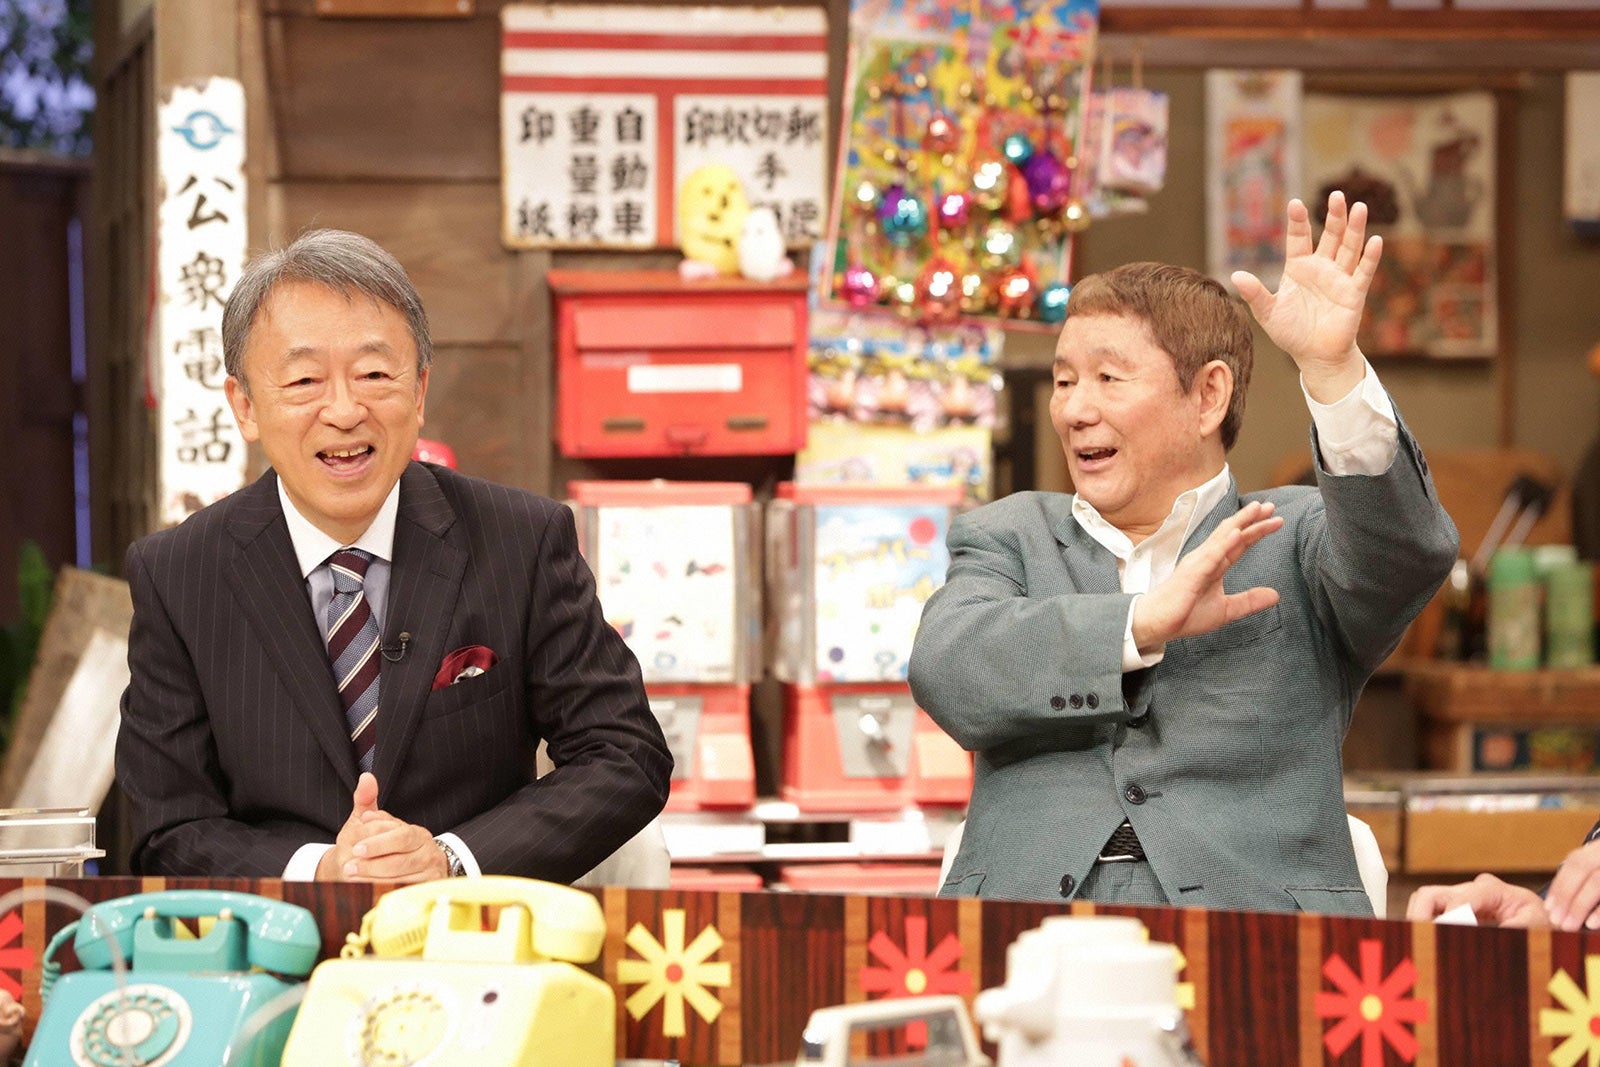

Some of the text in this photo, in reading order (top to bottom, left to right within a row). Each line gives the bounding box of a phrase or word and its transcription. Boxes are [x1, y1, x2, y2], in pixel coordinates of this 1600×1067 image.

[611, 105, 649, 238] 自動車
[173, 174, 236, 464] 公衆電話
